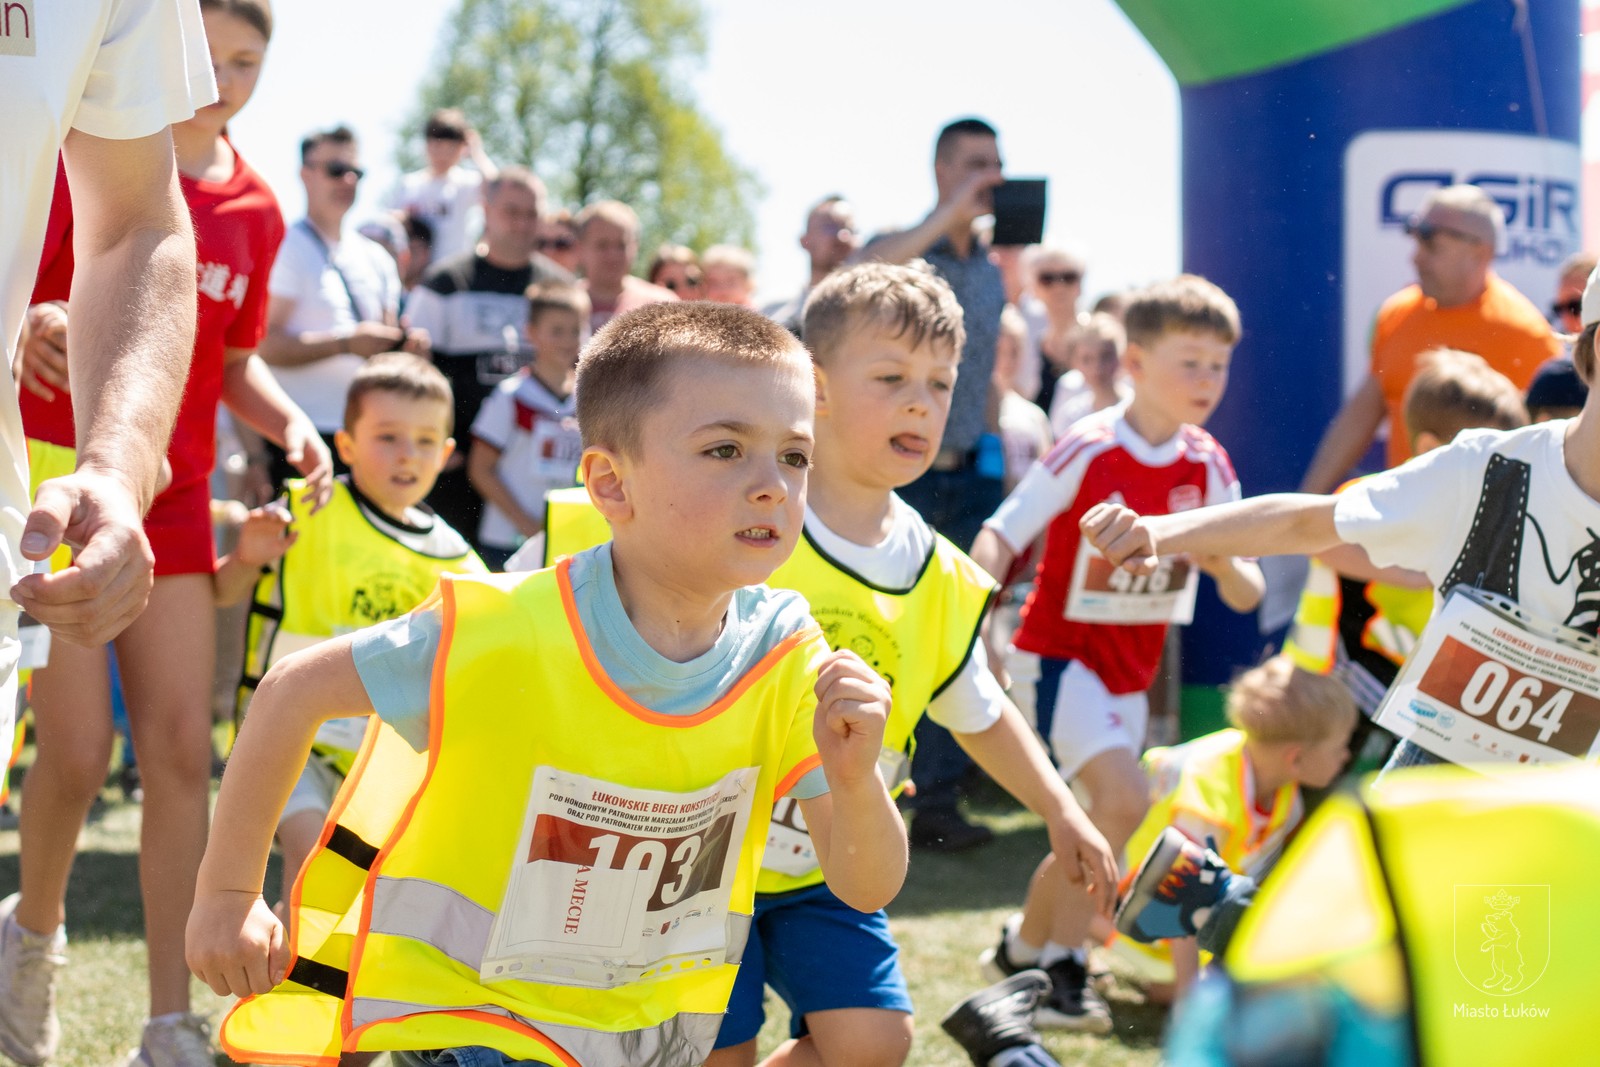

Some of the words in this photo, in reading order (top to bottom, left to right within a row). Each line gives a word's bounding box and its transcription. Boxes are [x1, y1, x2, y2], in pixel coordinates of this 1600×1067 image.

[1460, 660, 1575, 744] 064
[549, 792, 564, 802] POD
[564, 797, 607, 814] HONOROWYM
[608, 808, 651, 823] PATRONATEM
[651, 816, 686, 825] MARSZAŁKA
[567, 808, 584, 819] ORAZ
[585, 813, 600, 823] POD
[601, 817, 644, 831] PATRONATEM
[644, 825, 661, 833] RADY
[592, 791, 650, 812] ŁUKOWSKIE
[651, 803, 679, 815] BIEGI
[588, 833, 702, 905] 103
[564, 879, 589, 934] MECIE
